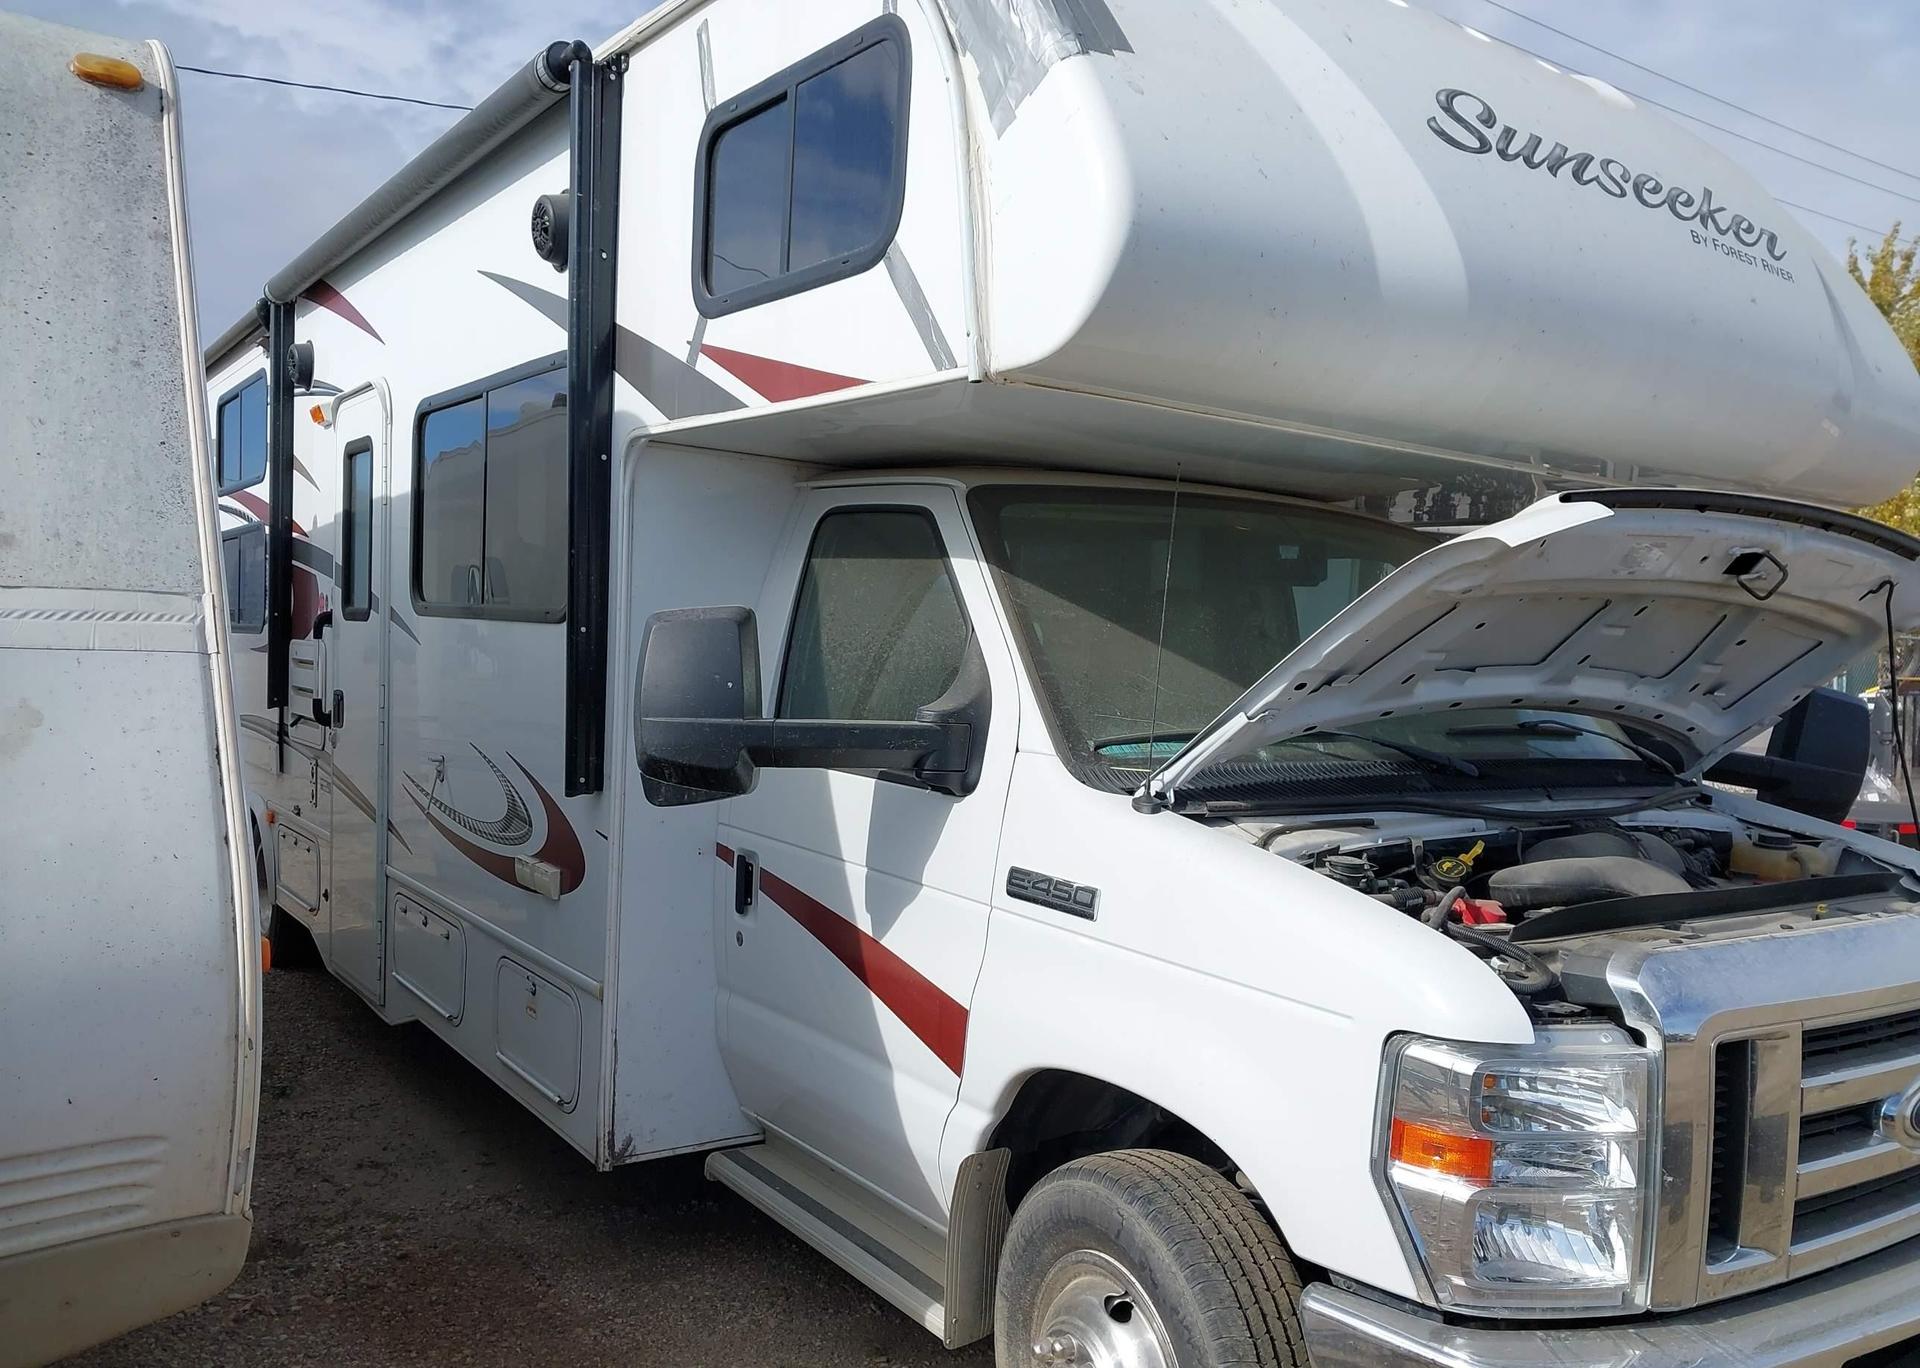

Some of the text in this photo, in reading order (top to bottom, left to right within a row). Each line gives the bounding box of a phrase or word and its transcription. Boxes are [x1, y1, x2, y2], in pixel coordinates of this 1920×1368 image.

[1427, 88, 1787, 261] Sunseeker
[1690, 229, 1794, 283] BY FOREST RIVER
